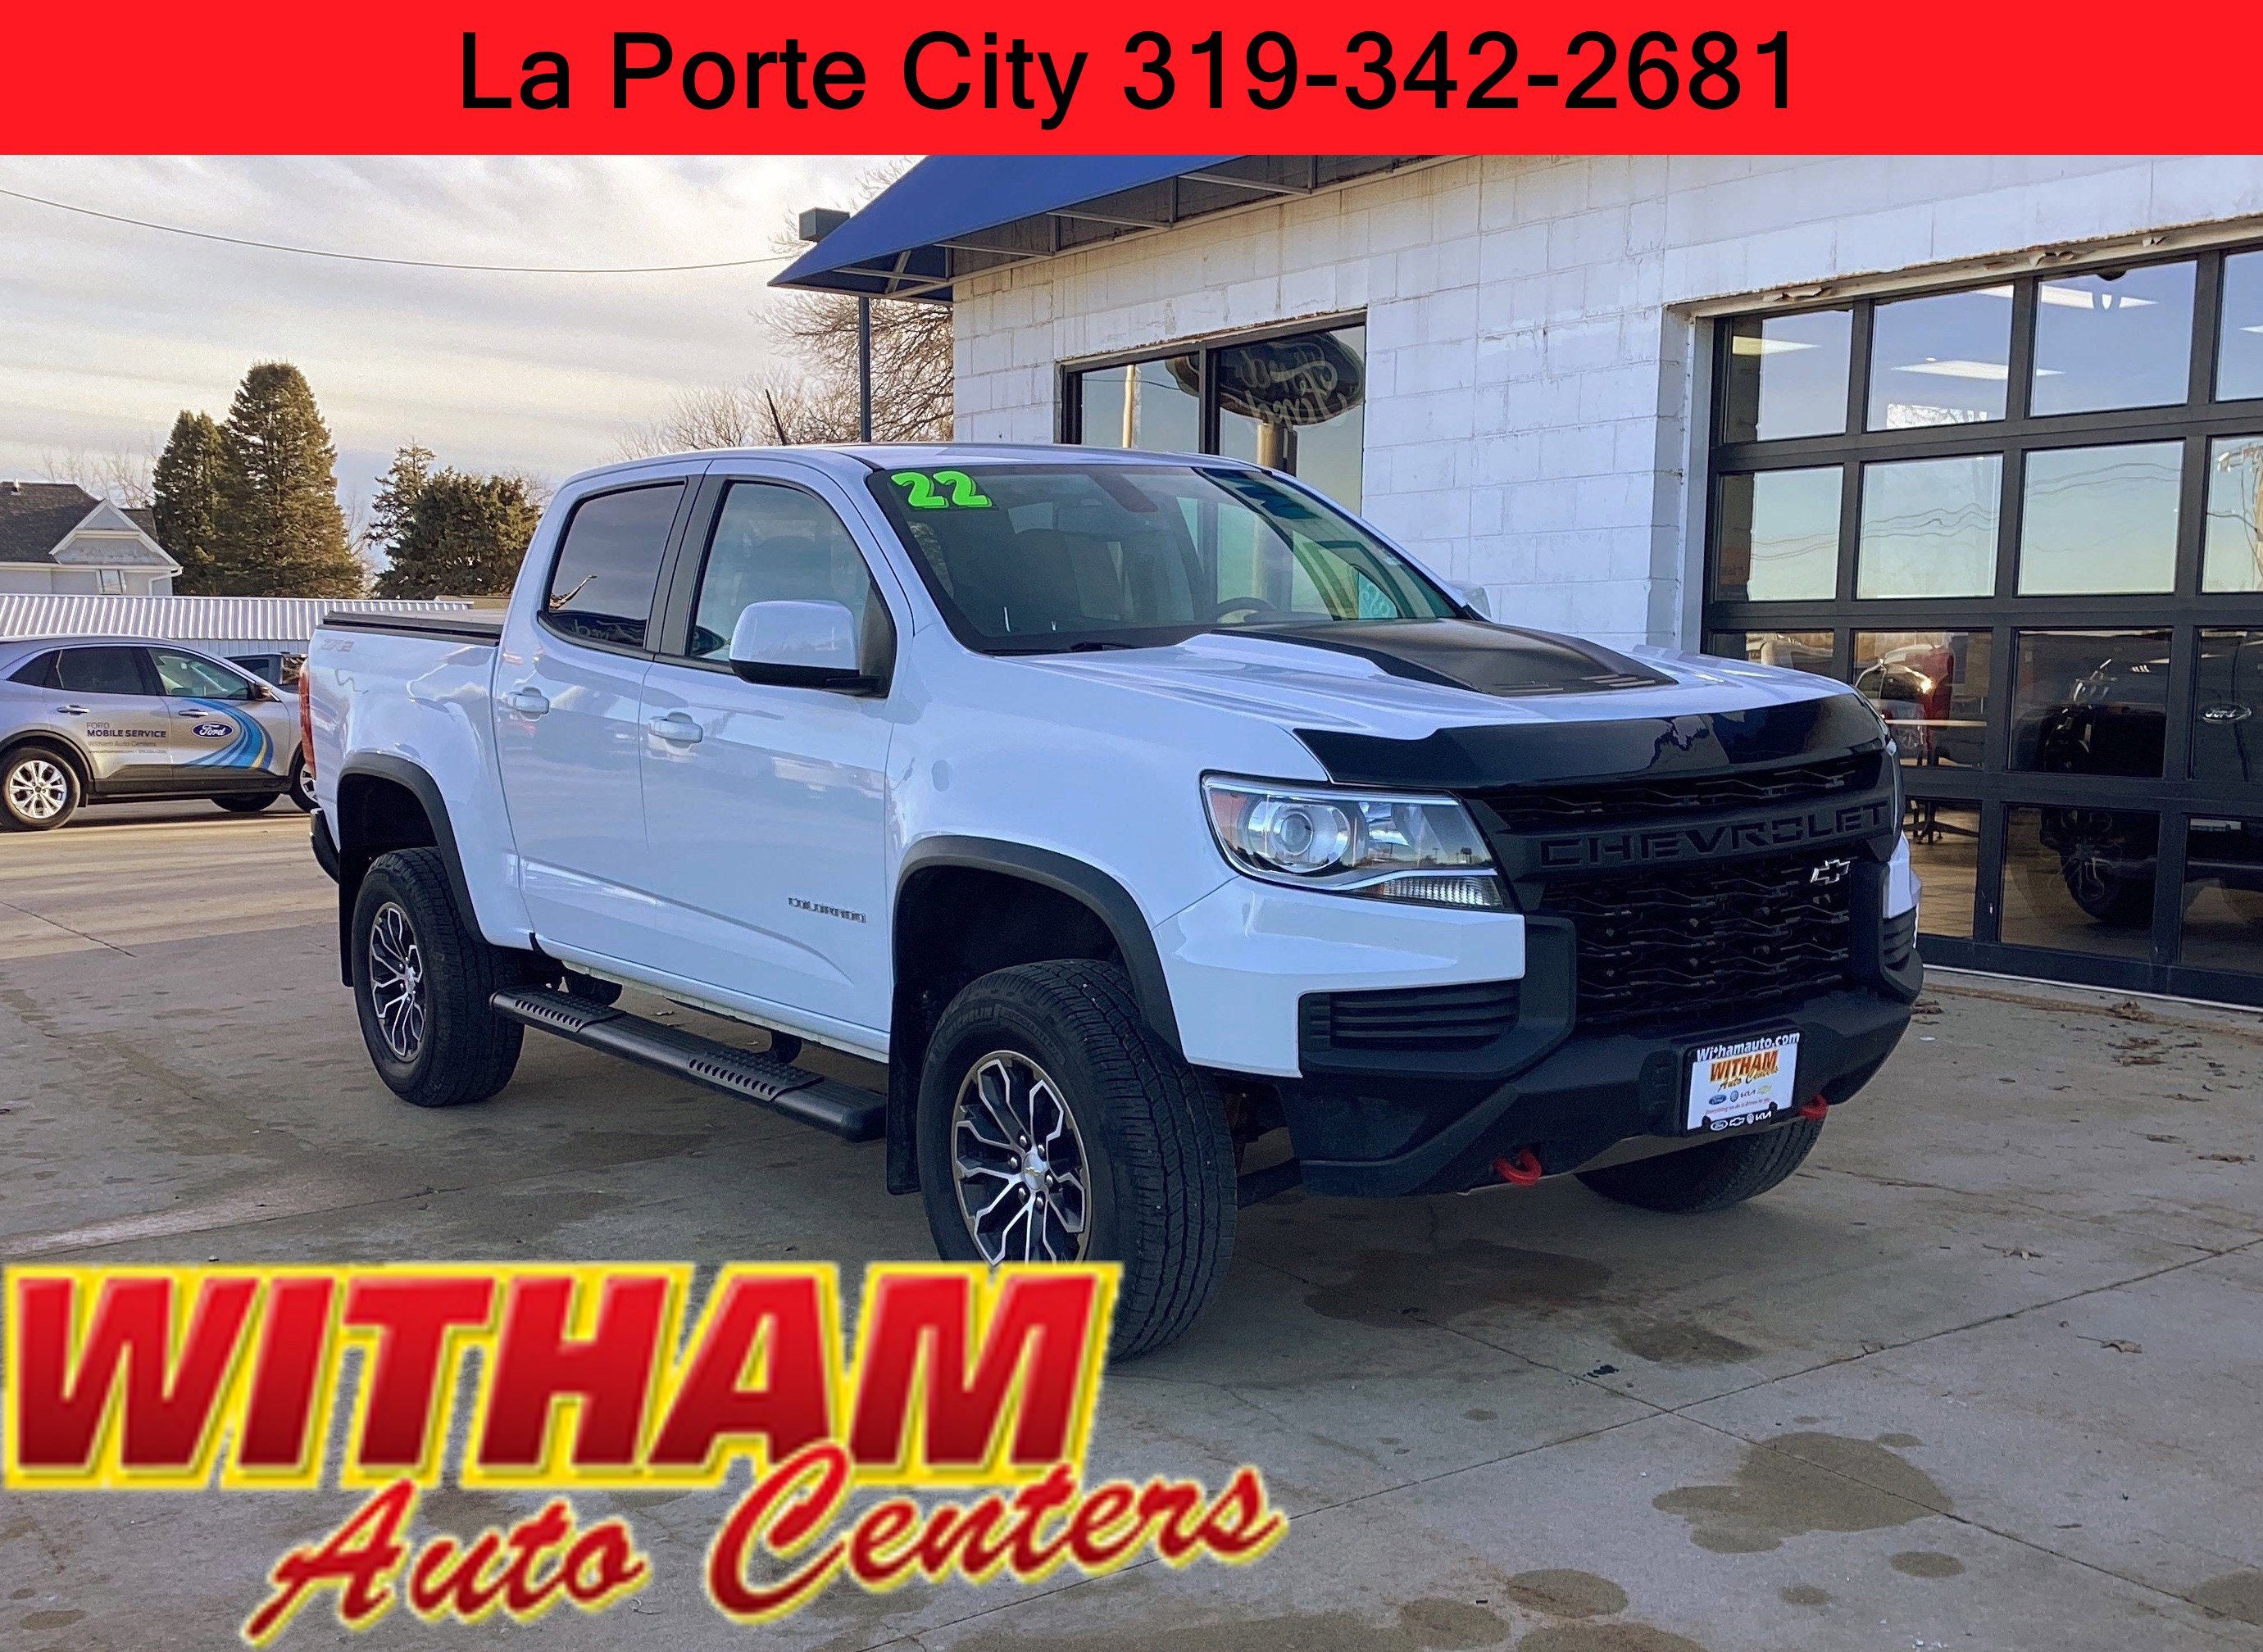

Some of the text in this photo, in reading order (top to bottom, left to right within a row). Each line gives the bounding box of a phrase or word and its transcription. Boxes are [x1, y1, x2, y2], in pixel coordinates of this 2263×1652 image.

[891, 470, 993, 508] 22
[125, 730, 166, 738] SERVICE
[198, 724, 227, 736] Ford
[1541, 802, 1887, 867] CHEVROLET
[1710, 1050, 1779, 1082] WITHAM
